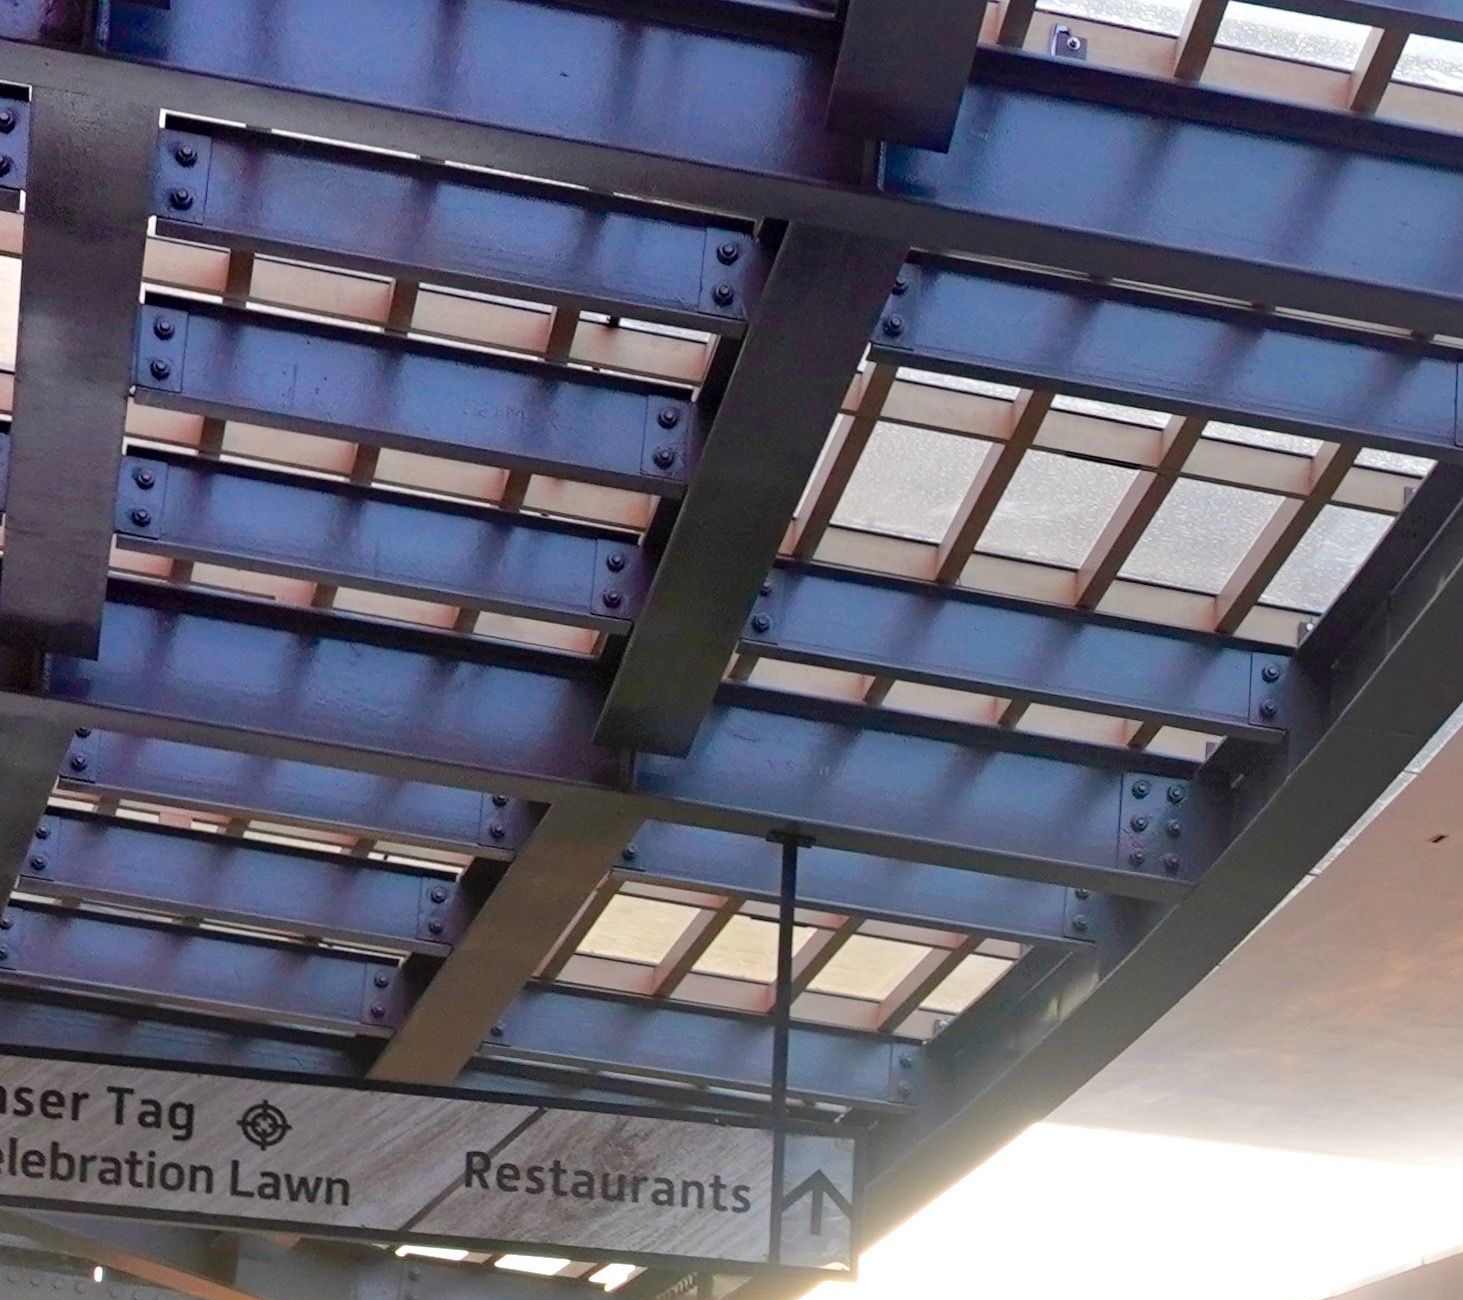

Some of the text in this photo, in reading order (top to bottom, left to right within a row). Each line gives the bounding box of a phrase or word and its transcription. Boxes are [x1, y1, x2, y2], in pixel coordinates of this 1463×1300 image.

[106, 1086, 195, 1141] Tag
[0, 1137, 350, 1206] lebration Lawn
[464, 1150, 752, 1214] Restaurants
